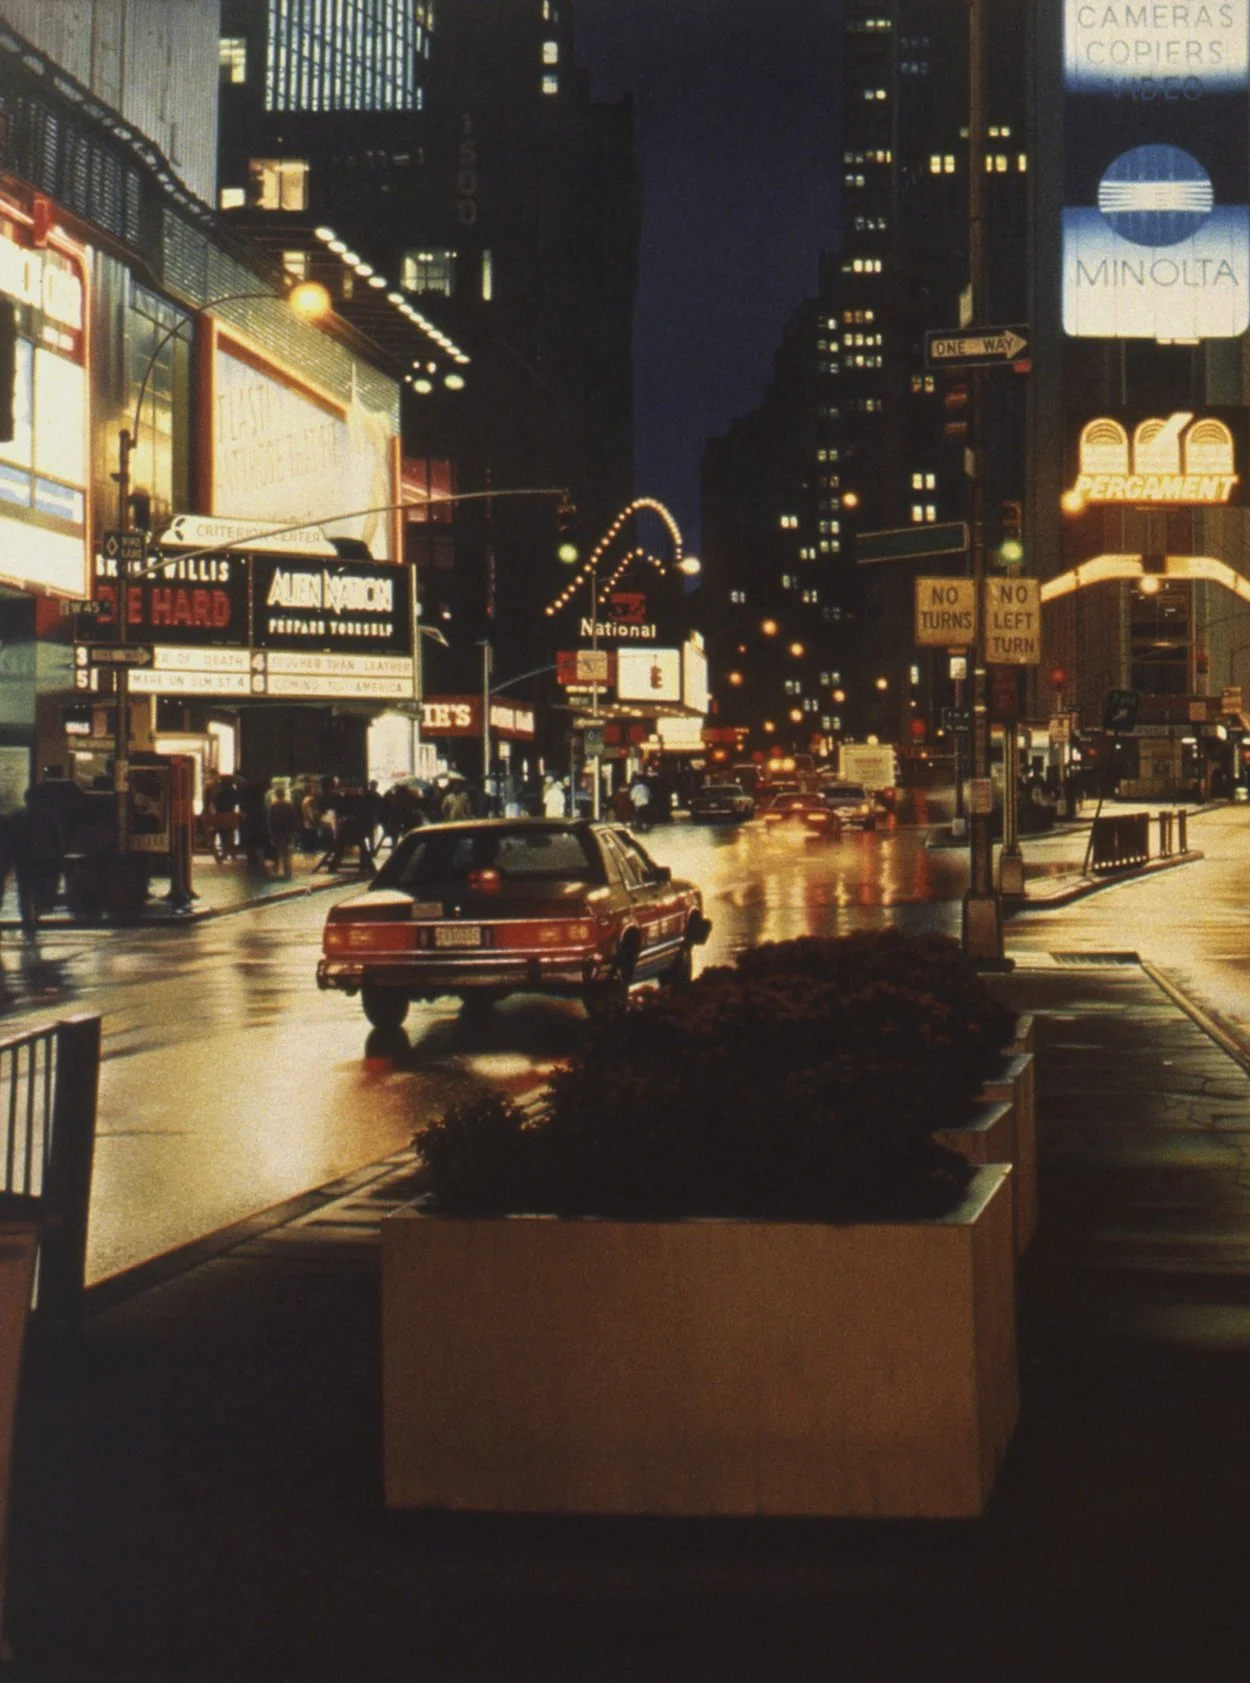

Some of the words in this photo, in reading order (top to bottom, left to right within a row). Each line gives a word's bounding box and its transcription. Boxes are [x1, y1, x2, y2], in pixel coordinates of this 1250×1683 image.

[1077, 4, 1234, 29] CAMERAS
[1085, 40, 1223, 66] COPIERS
[1107, 76, 1204, 102] VIDEO
[1076, 258, 1239, 288] MINOLTA
[935, 340, 965, 355] ONE
[982, 338, 1013, 353] WAY
[1075, 473, 1239, 503] PERGAMENT
[164, 558, 230, 582] WILLIS
[931, 586, 959, 607] NO
[1000, 585, 1028, 605] NO
[95, 587, 142, 625] DE
[151, 588, 230, 627] HARD
[580, 617, 657, 638] National
[920, 611, 973, 631] TURNS
[993, 612, 1033, 631] LEFT
[993, 635, 1035, 654] TURN
